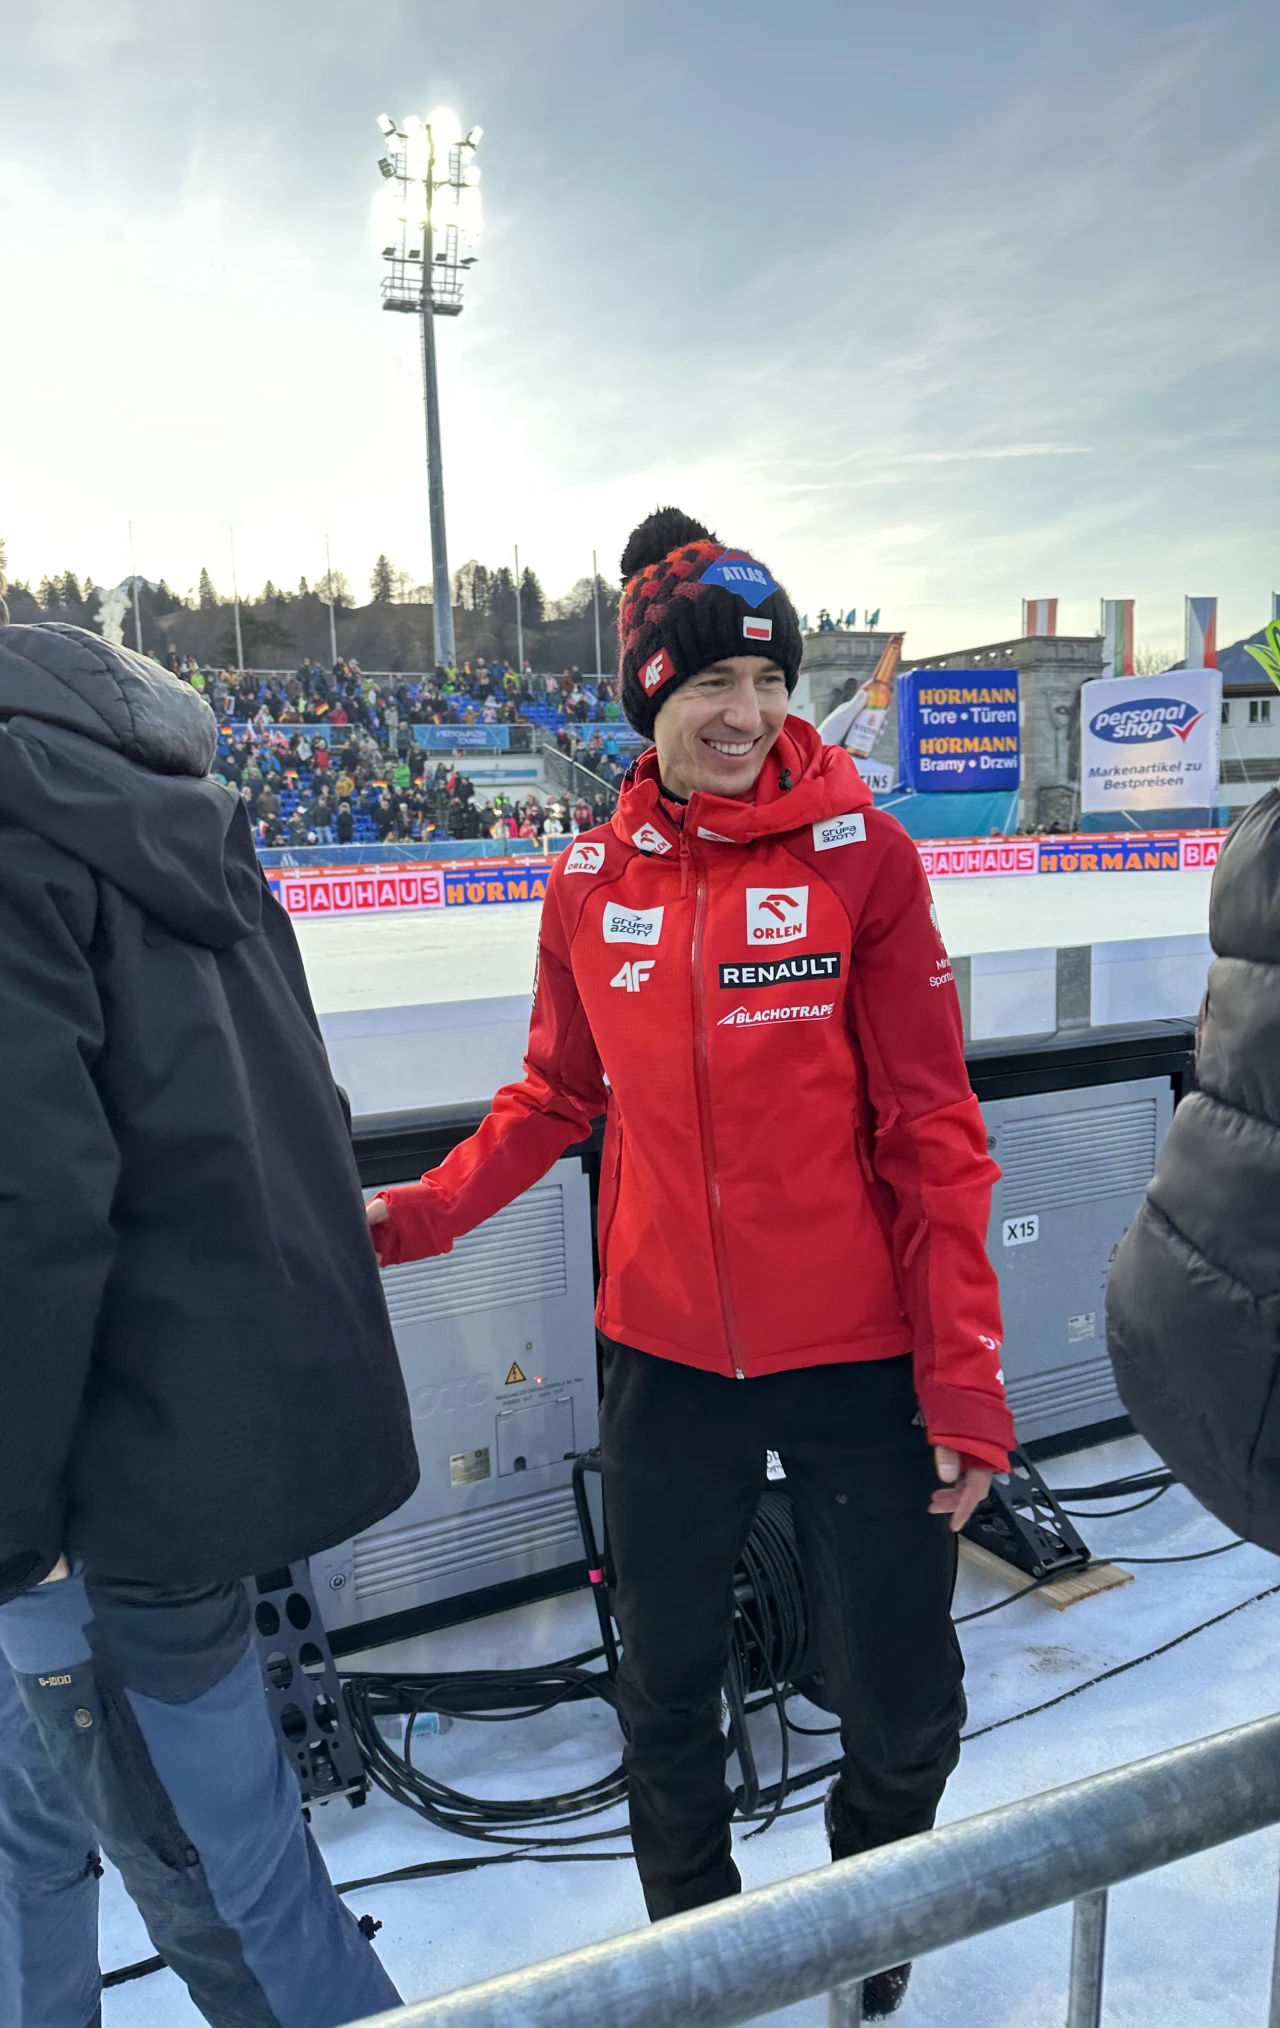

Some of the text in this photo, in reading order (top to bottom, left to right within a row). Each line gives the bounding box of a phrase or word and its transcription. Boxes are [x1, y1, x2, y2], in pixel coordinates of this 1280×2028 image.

[722, 566, 767, 585] ATLAS
[645, 654, 663, 689] 4F
[919, 688, 1016, 705] HÖRMANN
[919, 707, 1016, 725] Tore Türen
[1095, 704, 1187, 730] personal
[1112, 722, 1163, 738] shop
[920, 737, 1017, 754] HÖRMANN
[920, 755, 1018, 773] Bramy Drzwi
[1088, 761, 1202, 778] Markenartikel zu
[1103, 776, 1184, 790] Bestpreisen
[567, 863, 597, 871] ORLEN
[921, 850, 1032, 872] BAUHAUS
[1041, 852, 1178, 871] HÖRMANN
[288, 880, 439, 909] BAUHAUS
[753, 923, 802, 939] ORLEN
[610, 960, 656, 992] 4F
[723, 957, 837, 984] RENAULT
[1008, 1221, 1035, 1240] X15
